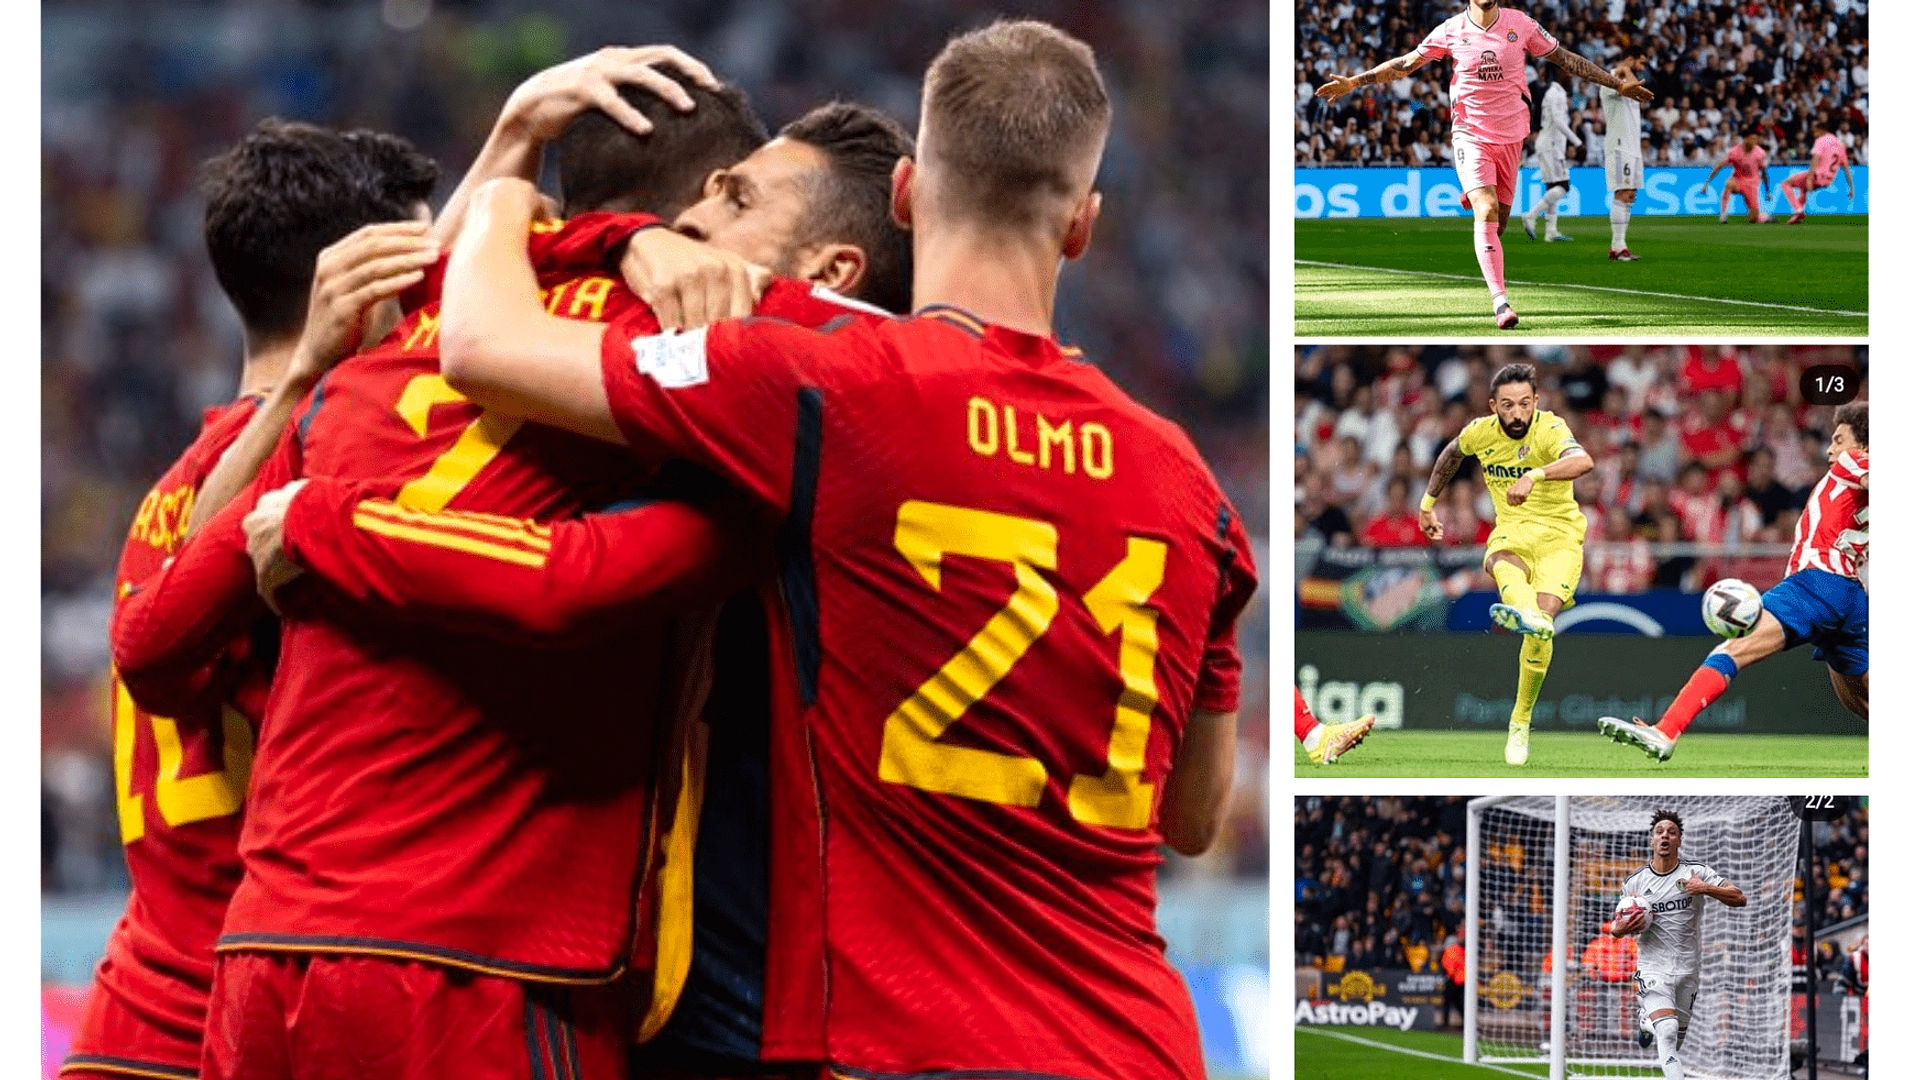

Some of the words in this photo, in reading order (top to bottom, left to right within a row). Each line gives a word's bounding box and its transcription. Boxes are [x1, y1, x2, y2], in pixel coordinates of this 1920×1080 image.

[1479, 73, 1504, 81] MAYA
[1623, 163, 1631, 177] 6
[1295, 183, 1361, 218] os
[1380, 170, 1463, 218] de
[1509, 167, 1581, 217] ía
[967, 396, 1115, 480] OLMO
[1483, 464, 1533, 479] AMES
[879, 499, 1168, 830] 21
[1652, 897, 1693, 913] SBOTOP
[1295, 999, 1419, 1031] AstroPay
